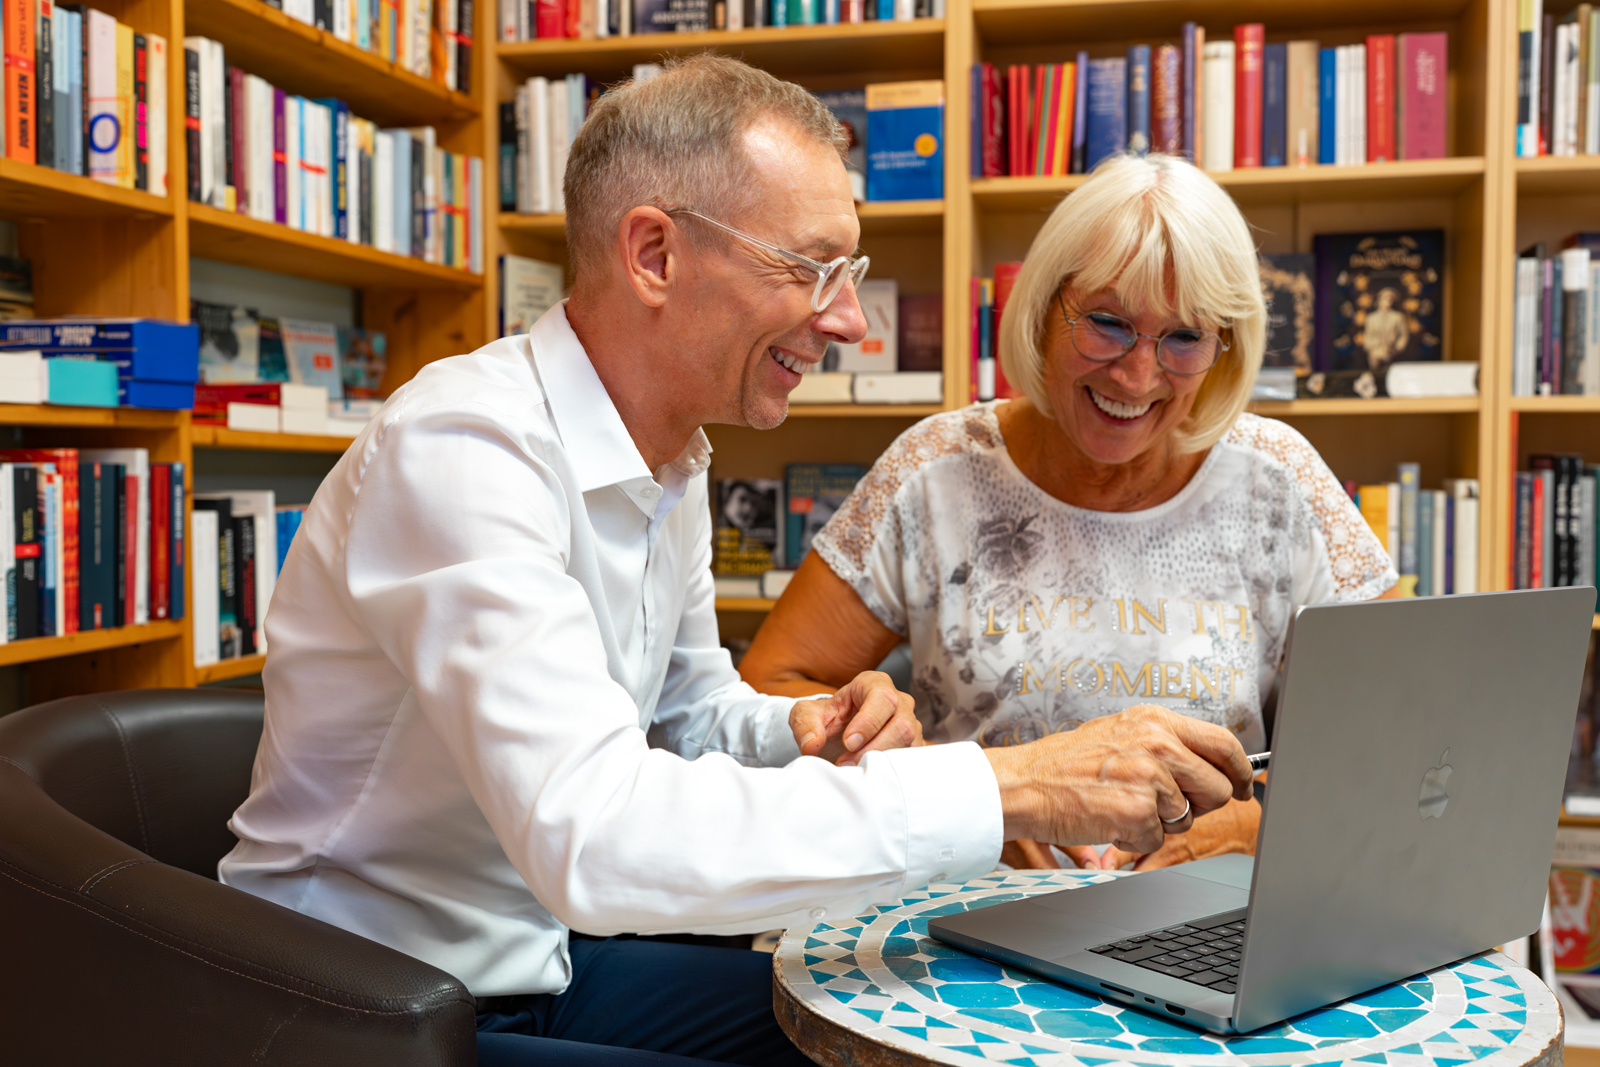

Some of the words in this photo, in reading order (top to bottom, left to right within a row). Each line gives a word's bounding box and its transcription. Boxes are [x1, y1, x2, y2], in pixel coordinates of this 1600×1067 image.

[18, 73, 28, 115] NIVEN
[18, 117, 29, 149] JOHN
[982, 595, 1095, 636] LIVE
[1112, 597, 1173, 636] IN
[1183, 598, 1256, 642] TH
[1016, 656, 1244, 705] MOMENT
